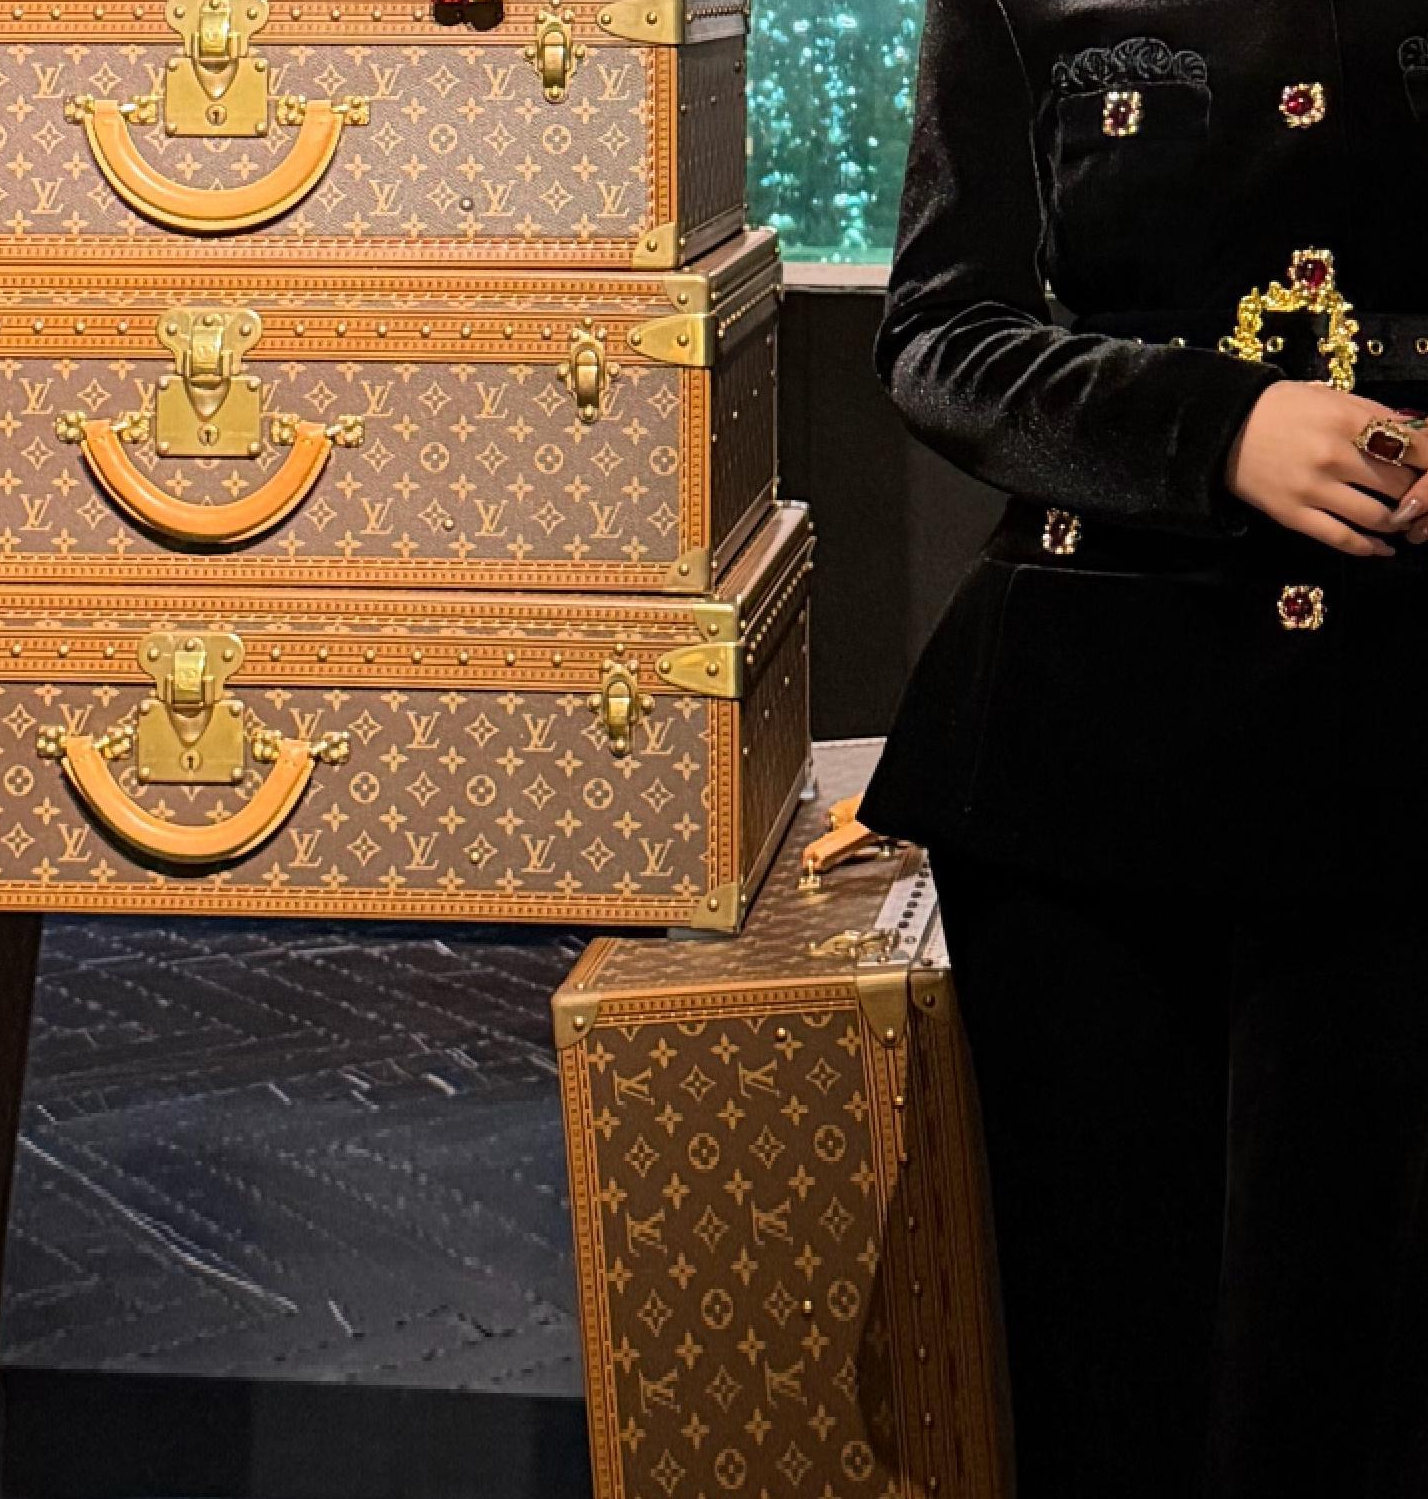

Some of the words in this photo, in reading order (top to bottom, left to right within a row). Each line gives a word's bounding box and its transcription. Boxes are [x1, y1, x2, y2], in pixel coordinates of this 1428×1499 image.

[32, 63, 66, 98] LV
[371, 64, 405, 100] LV
[484, 64, 516, 100] LV
[597, 64, 631, 100] LV
[32, 178, 66, 214] LV
[371, 180, 403, 215] LV
[482, 180, 513, 216] LV
[596, 181, 630, 218] LV
[20, 378, 53, 414] LV
[361, 383, 393, 417] LV
[474, 384, 509, 418] LV
[19, 494, 53, 530] LV
[359, 498, 393, 534] LV
[473, 500, 507, 537] LV
[589, 502, 623, 538] LV
[405, 711, 440, 750] LV
[522, 713, 557, 753] LV
[638, 714, 673, 755] LV
[57, 824, 92, 862] LV
[288, 830, 322, 868] LV
[404, 831, 439, 870] LV
[521, 834, 556, 873] LV
[638, 838, 673, 876] LV
